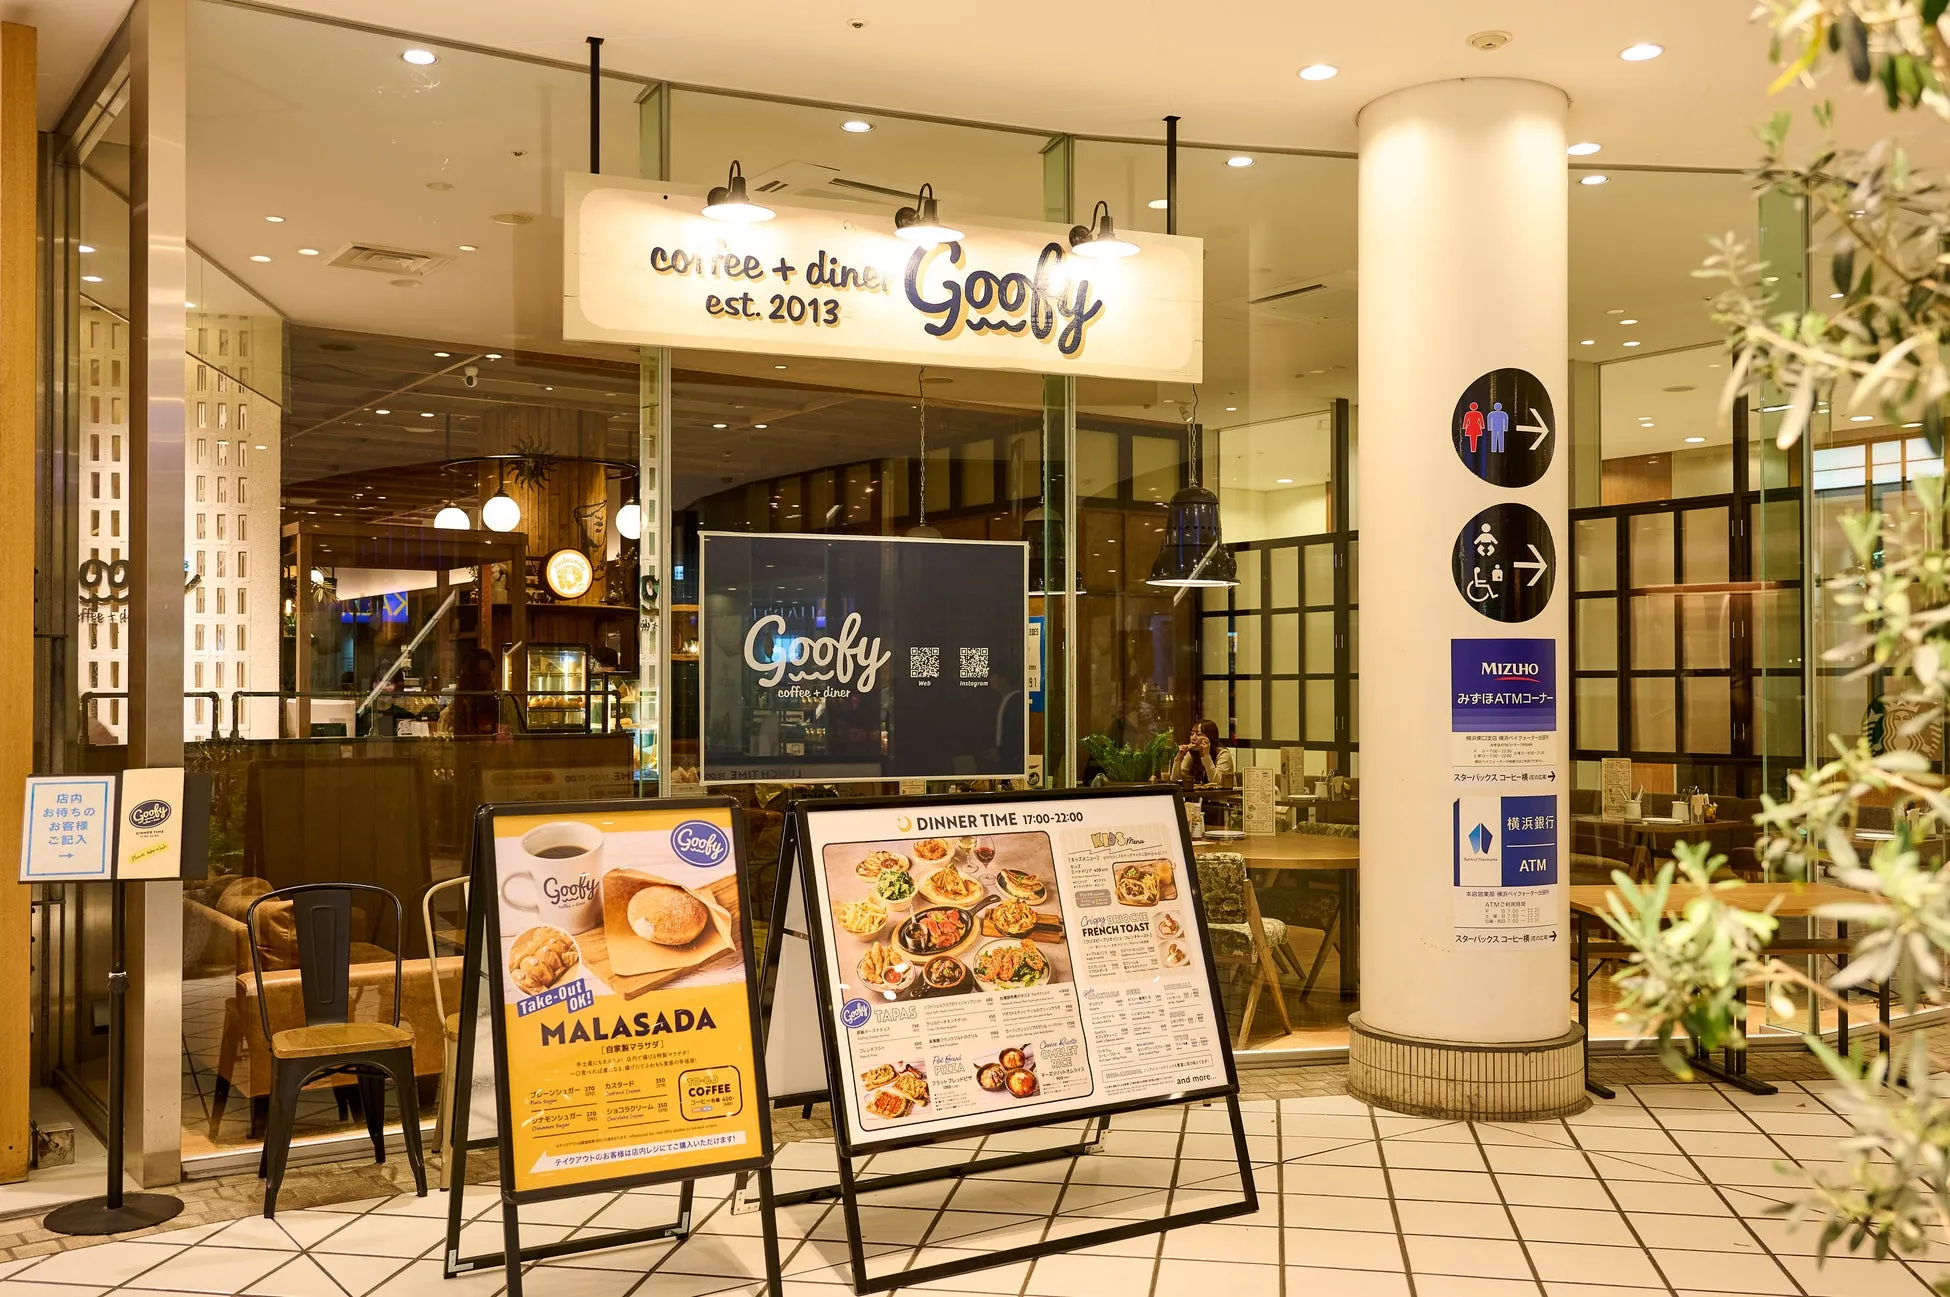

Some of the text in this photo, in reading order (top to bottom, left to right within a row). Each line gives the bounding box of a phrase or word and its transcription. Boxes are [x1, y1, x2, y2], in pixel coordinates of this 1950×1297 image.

[772, 258, 796, 283] +
[904, 240, 1104, 357] Goofy
[706, 292, 841, 327] est. 2013
[744, 612, 891, 693] Goofy
[1482, 662, 1539, 675] MIZUHO
[778, 686, 811, 698] coffee
[823, 686, 850, 698] diner
[1458, 693, 1554, 704] みずほATMコーナー
[1454, 773, 1528, 782] スターバックス コーヒー横
[57, 794, 82, 804] 店内
[43, 808, 95, 818] お待ちの
[132, 804, 168, 824] Goofy
[49, 821, 88, 831] お客様
[917, 812, 1083, 831] DINNER TIME 17:00-22:00
[1507, 816, 1555, 831] 横浜銀行
[48, 835, 87, 845] ご記入
[677, 828, 724, 860] Goofy
[1090, 832, 1126, 849] KIDS
[1520, 859, 1547, 872] ATM
[544, 873, 599, 905] Goofy
[1080, 912, 1149, 928] Crispy BRIOCHE
[1082, 922, 1150, 937] FRENCH TOAST
[1456, 934, 1529, 943] スターバックス コーヒー横
[520, 980, 582, 1013] Take-Out
[570, 991, 593, 1012] OK!
[843, 1002, 868, 1024] Goofy
[874, 1006, 917, 1023] TAPAS
[541, 1007, 716, 1046] MALASADA
[1040, 1045, 1078, 1060] OMELET
[934, 1063, 965, 1076] PIZZA
[1051, 1057, 1073, 1069] RICE
[605, 1080, 634, 1090] カスタード
[1177, 1074, 1216, 1085] and more...
[531, 1087, 580, 1099] プレーンシュガー
[688, 1084, 731, 1097] COFFEE
[607, 1104, 654, 1115] ショコラクリーム
[532, 1113, 582, 1125] シナモンシュガー
